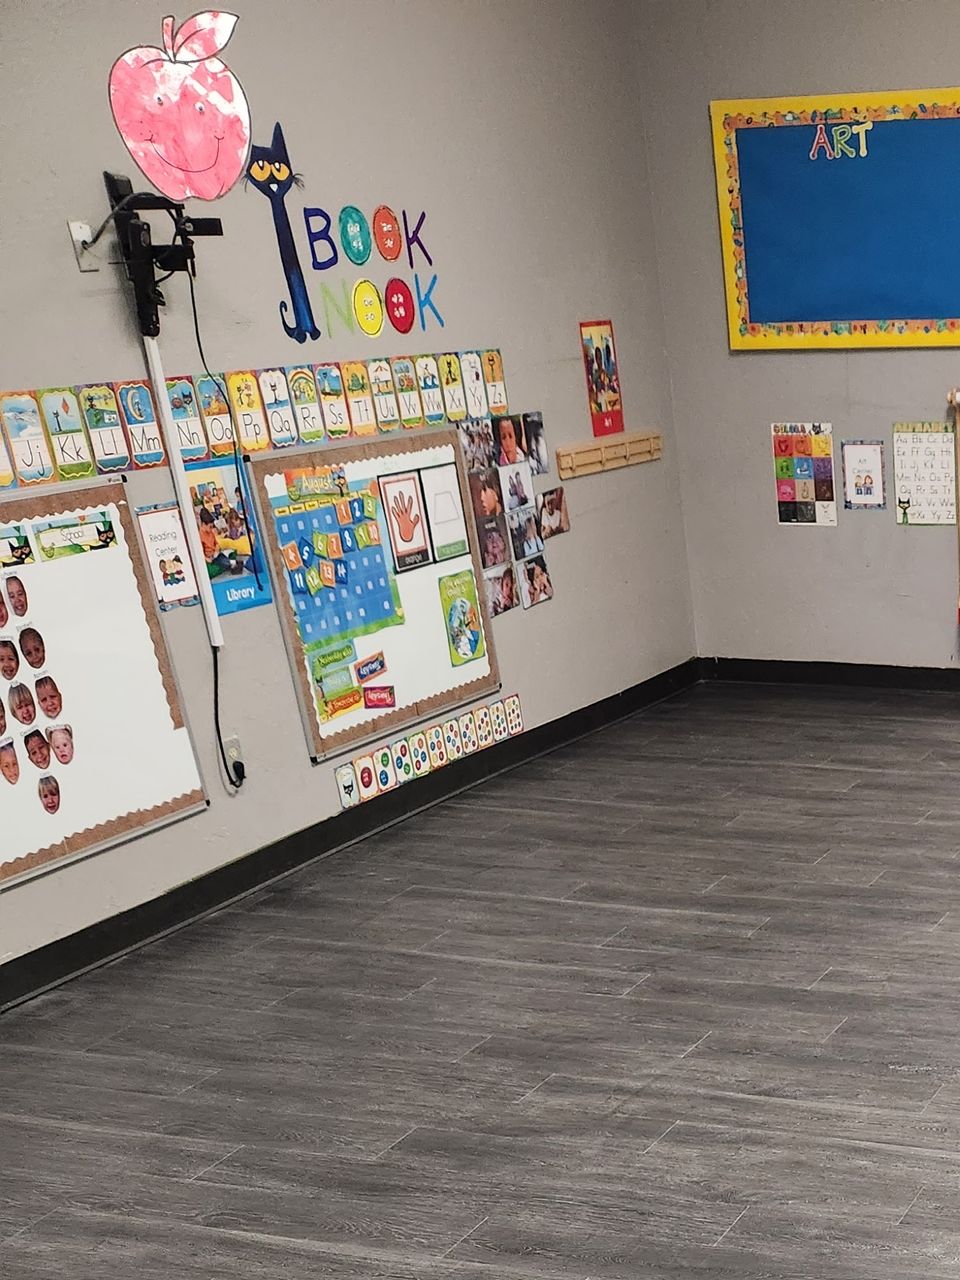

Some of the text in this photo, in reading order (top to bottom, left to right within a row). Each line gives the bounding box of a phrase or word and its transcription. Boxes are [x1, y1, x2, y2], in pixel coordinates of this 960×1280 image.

[809, 121, 873, 160] ART
[303, 205, 432, 270] BOOK
[320, 273, 444, 338] NOOK
[22, 440, 45, 477] Jj
[57, 435, 84, 462] Kk
[98, 427, 116, 456] Ll
[130, 427, 160, 451] Mm
[178, 422, 200, 446] Nn
[243, 414, 261, 443] Pp
[271, 411, 293, 440] Qq
[301, 407, 317, 428] Rr
[330, 404, 344, 425] Ss
[354, 400, 369, 422] Tt
[379, 398, 395, 418] Uu
[403, 398, 419, 415] Vv
[424, 392, 442, 411] Ww
[449, 390, 463, 408] Xx
[468, 388, 482, 408] Yy
[490, 385, 502, 404] Zz
[302, 476, 332, 493] August
[340, 499, 373, 516] 1 2 3
[149, 528, 176, 544] Reading
[288, 549, 297, 562] 4
[302, 546, 310, 561] 5
[318, 536, 324, 546] 6
[344, 531, 352, 547] 8
[154, 544, 178, 558] Center
[294, 564, 346, 588] 11 12 13 14
[226, 586, 256, 603] Library
